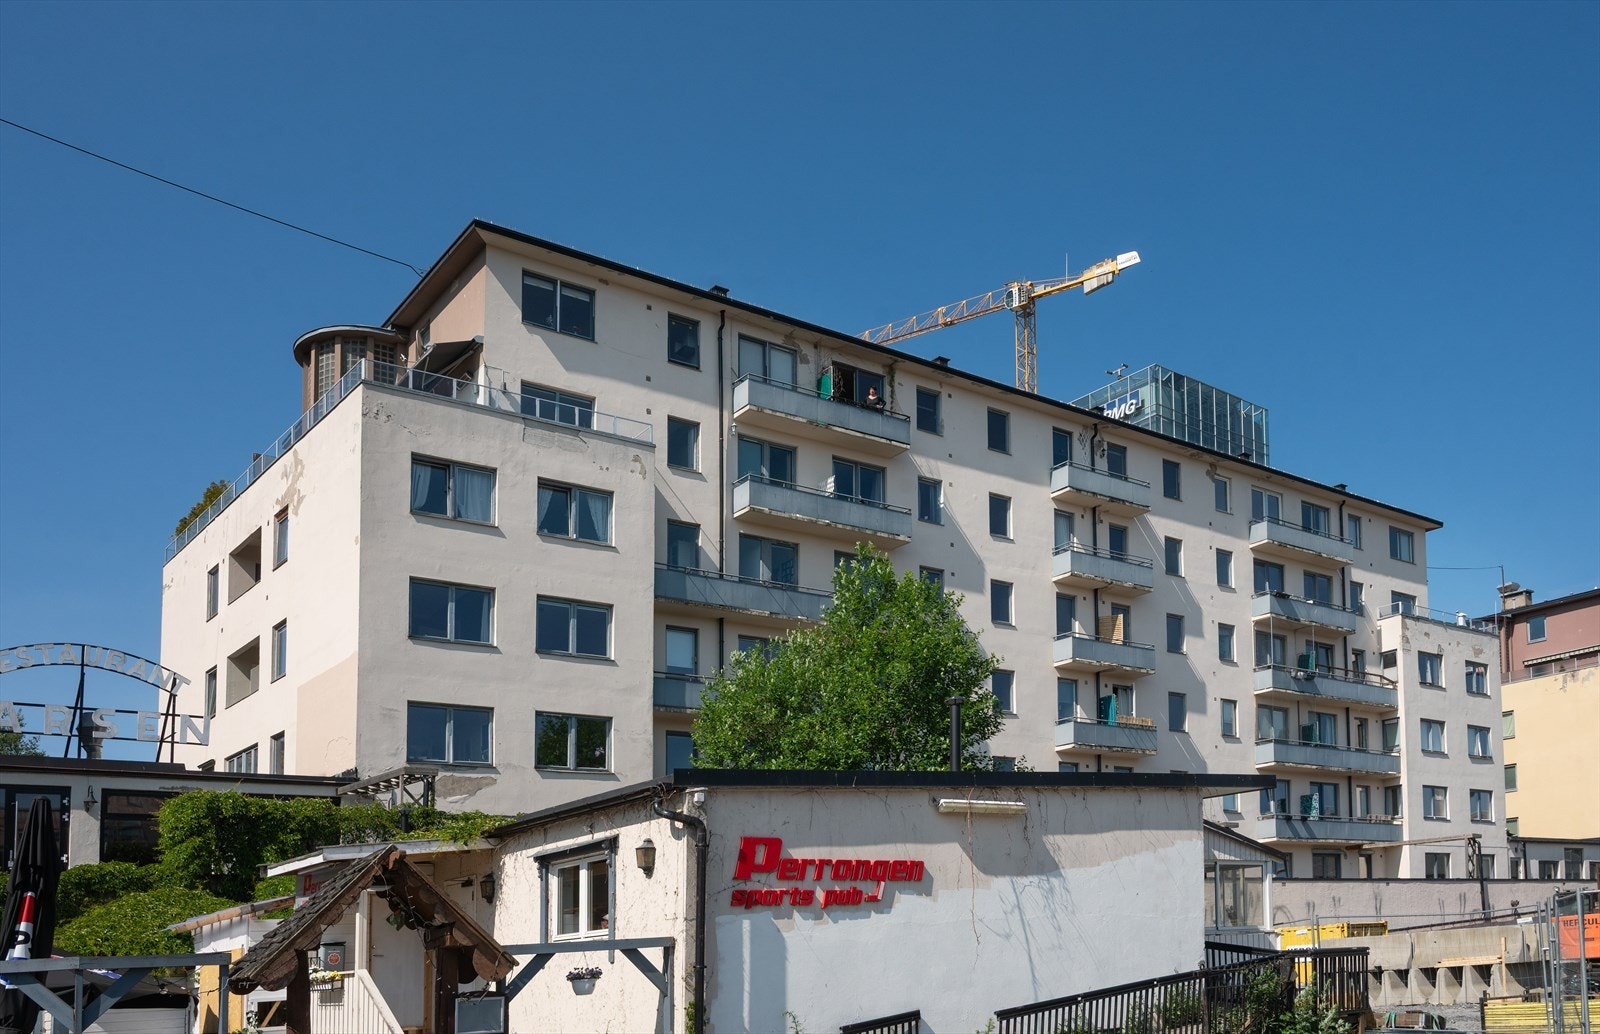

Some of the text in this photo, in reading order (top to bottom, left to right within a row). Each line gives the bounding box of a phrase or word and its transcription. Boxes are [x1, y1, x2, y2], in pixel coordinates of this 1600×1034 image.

[0, 702, 211, 746] ARSEN
[732, 836, 925, 902] Perrongen
[730, 886, 863, 909] sports pub
